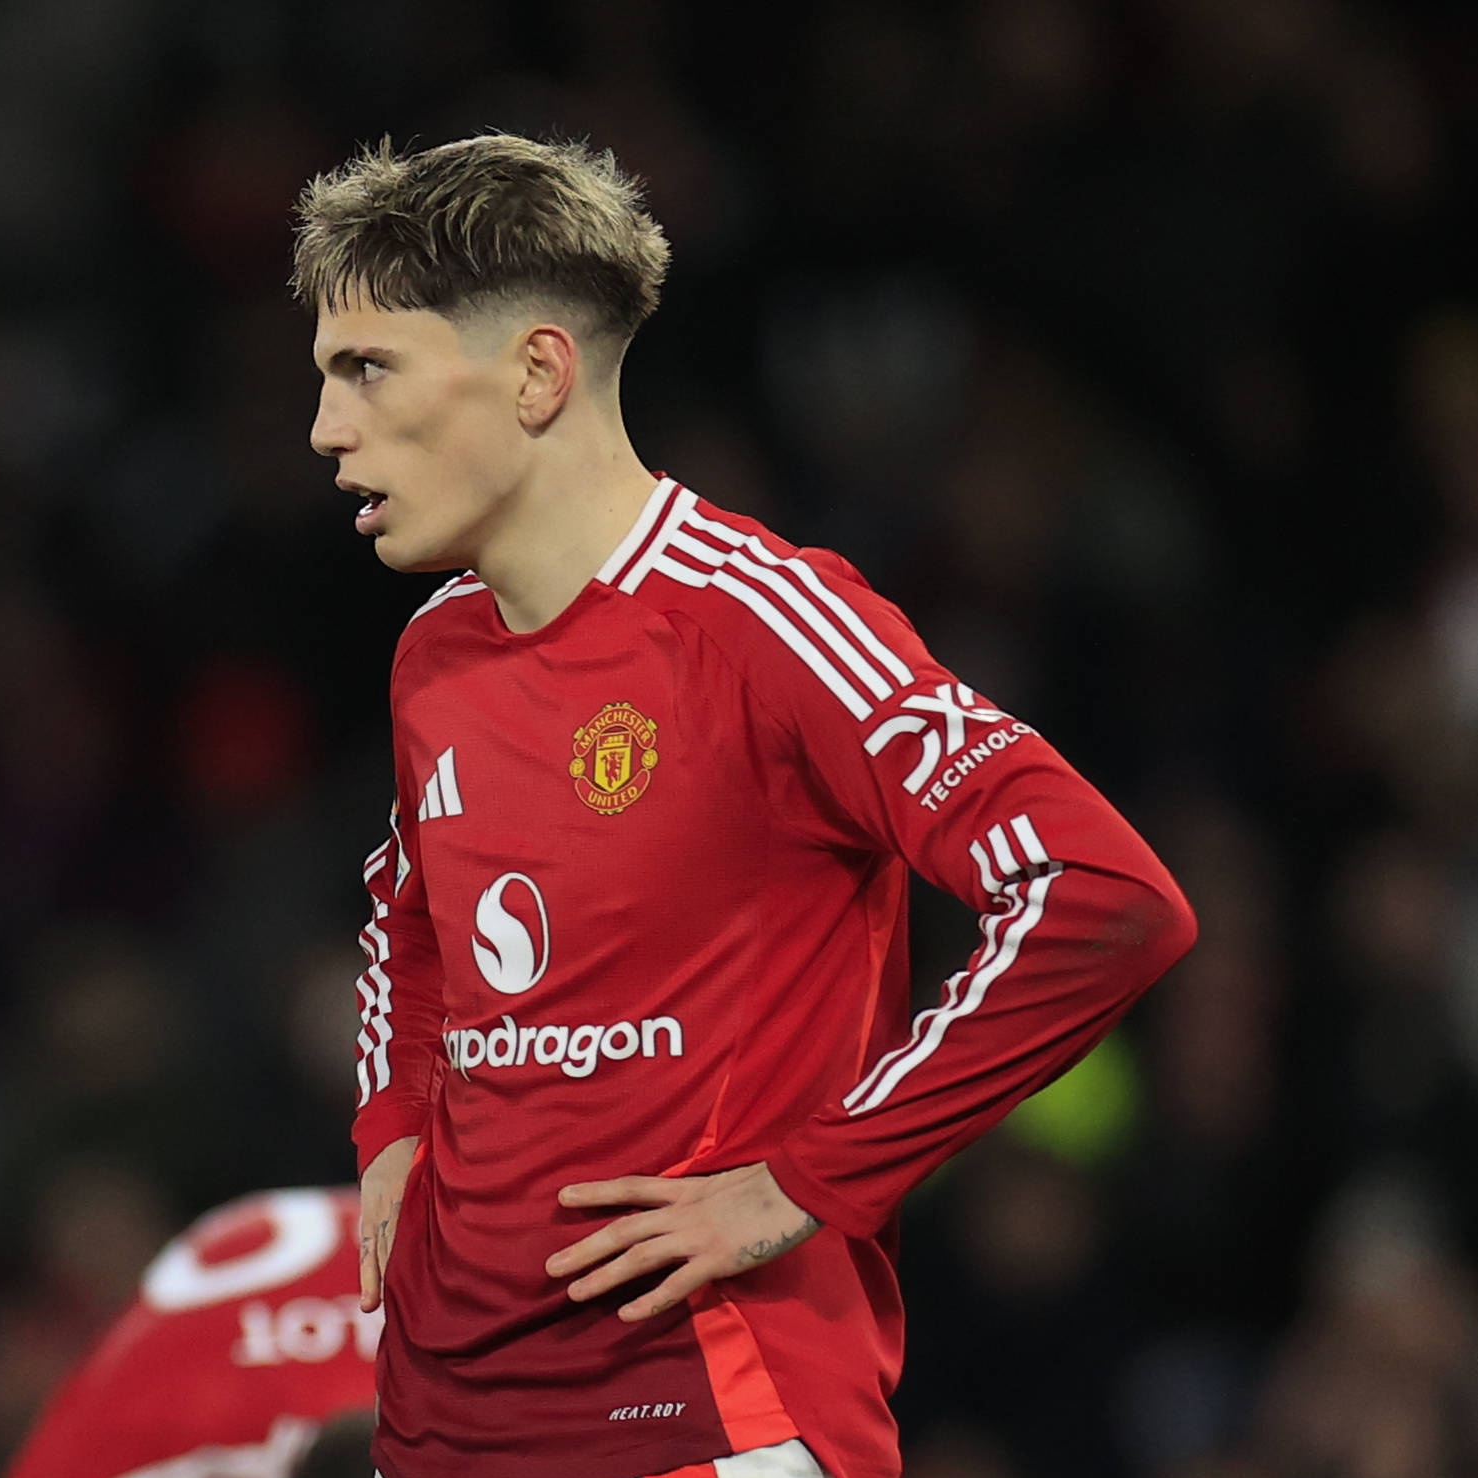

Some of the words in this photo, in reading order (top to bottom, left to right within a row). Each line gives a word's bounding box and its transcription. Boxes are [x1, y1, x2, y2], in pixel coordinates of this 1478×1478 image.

[580, 711, 651, 750] MANCHESTER
[920, 722, 1041, 812] TECHNOLO
[588, 786, 638, 807] UNITED
[442, 1013, 683, 1083] apdragon
